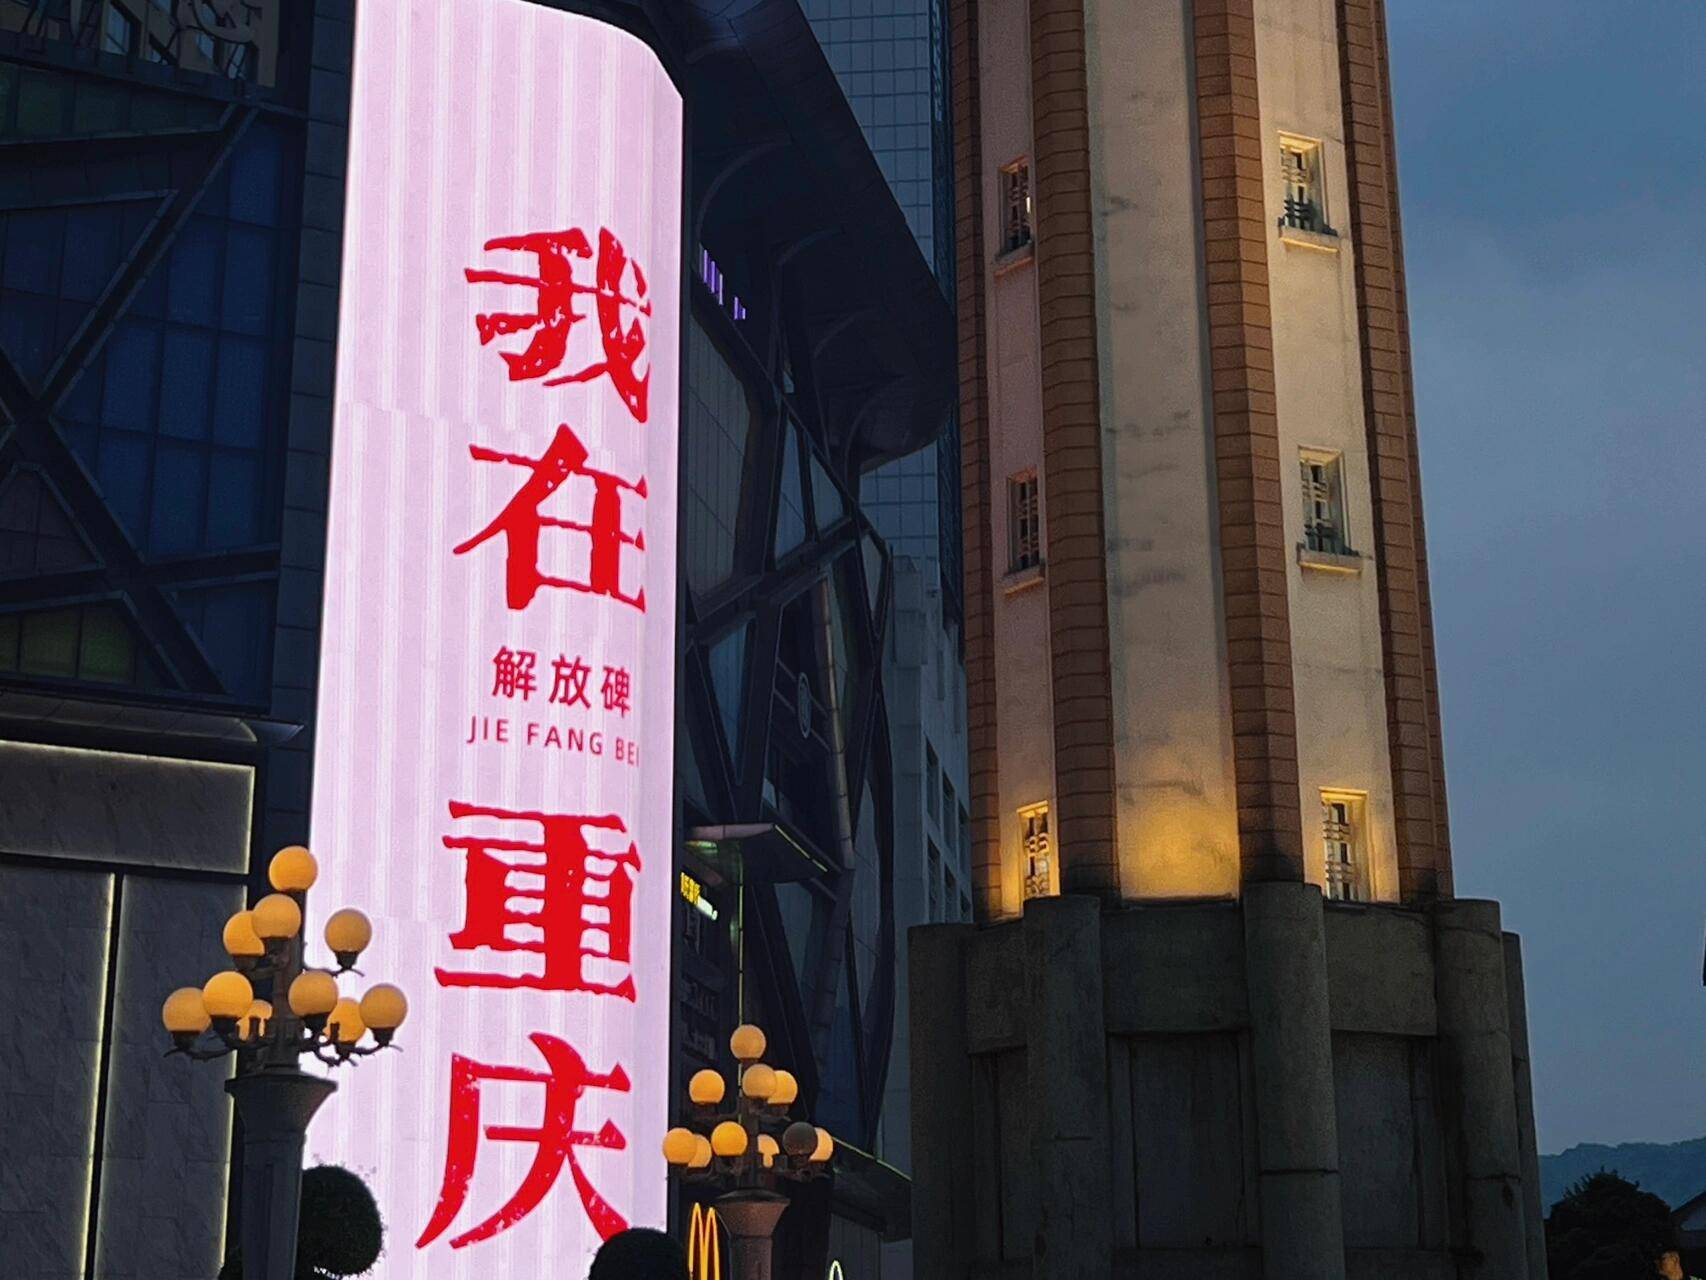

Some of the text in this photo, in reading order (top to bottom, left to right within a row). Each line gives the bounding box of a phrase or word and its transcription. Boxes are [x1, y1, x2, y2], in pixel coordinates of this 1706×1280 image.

[453, 226, 651, 614] 我在
[467, 715, 509, 744] JIE
[527, 723, 602, 755] FANG
[492, 645, 631, 718] 解放碑
[416, 800, 643, 1250] 重庆
